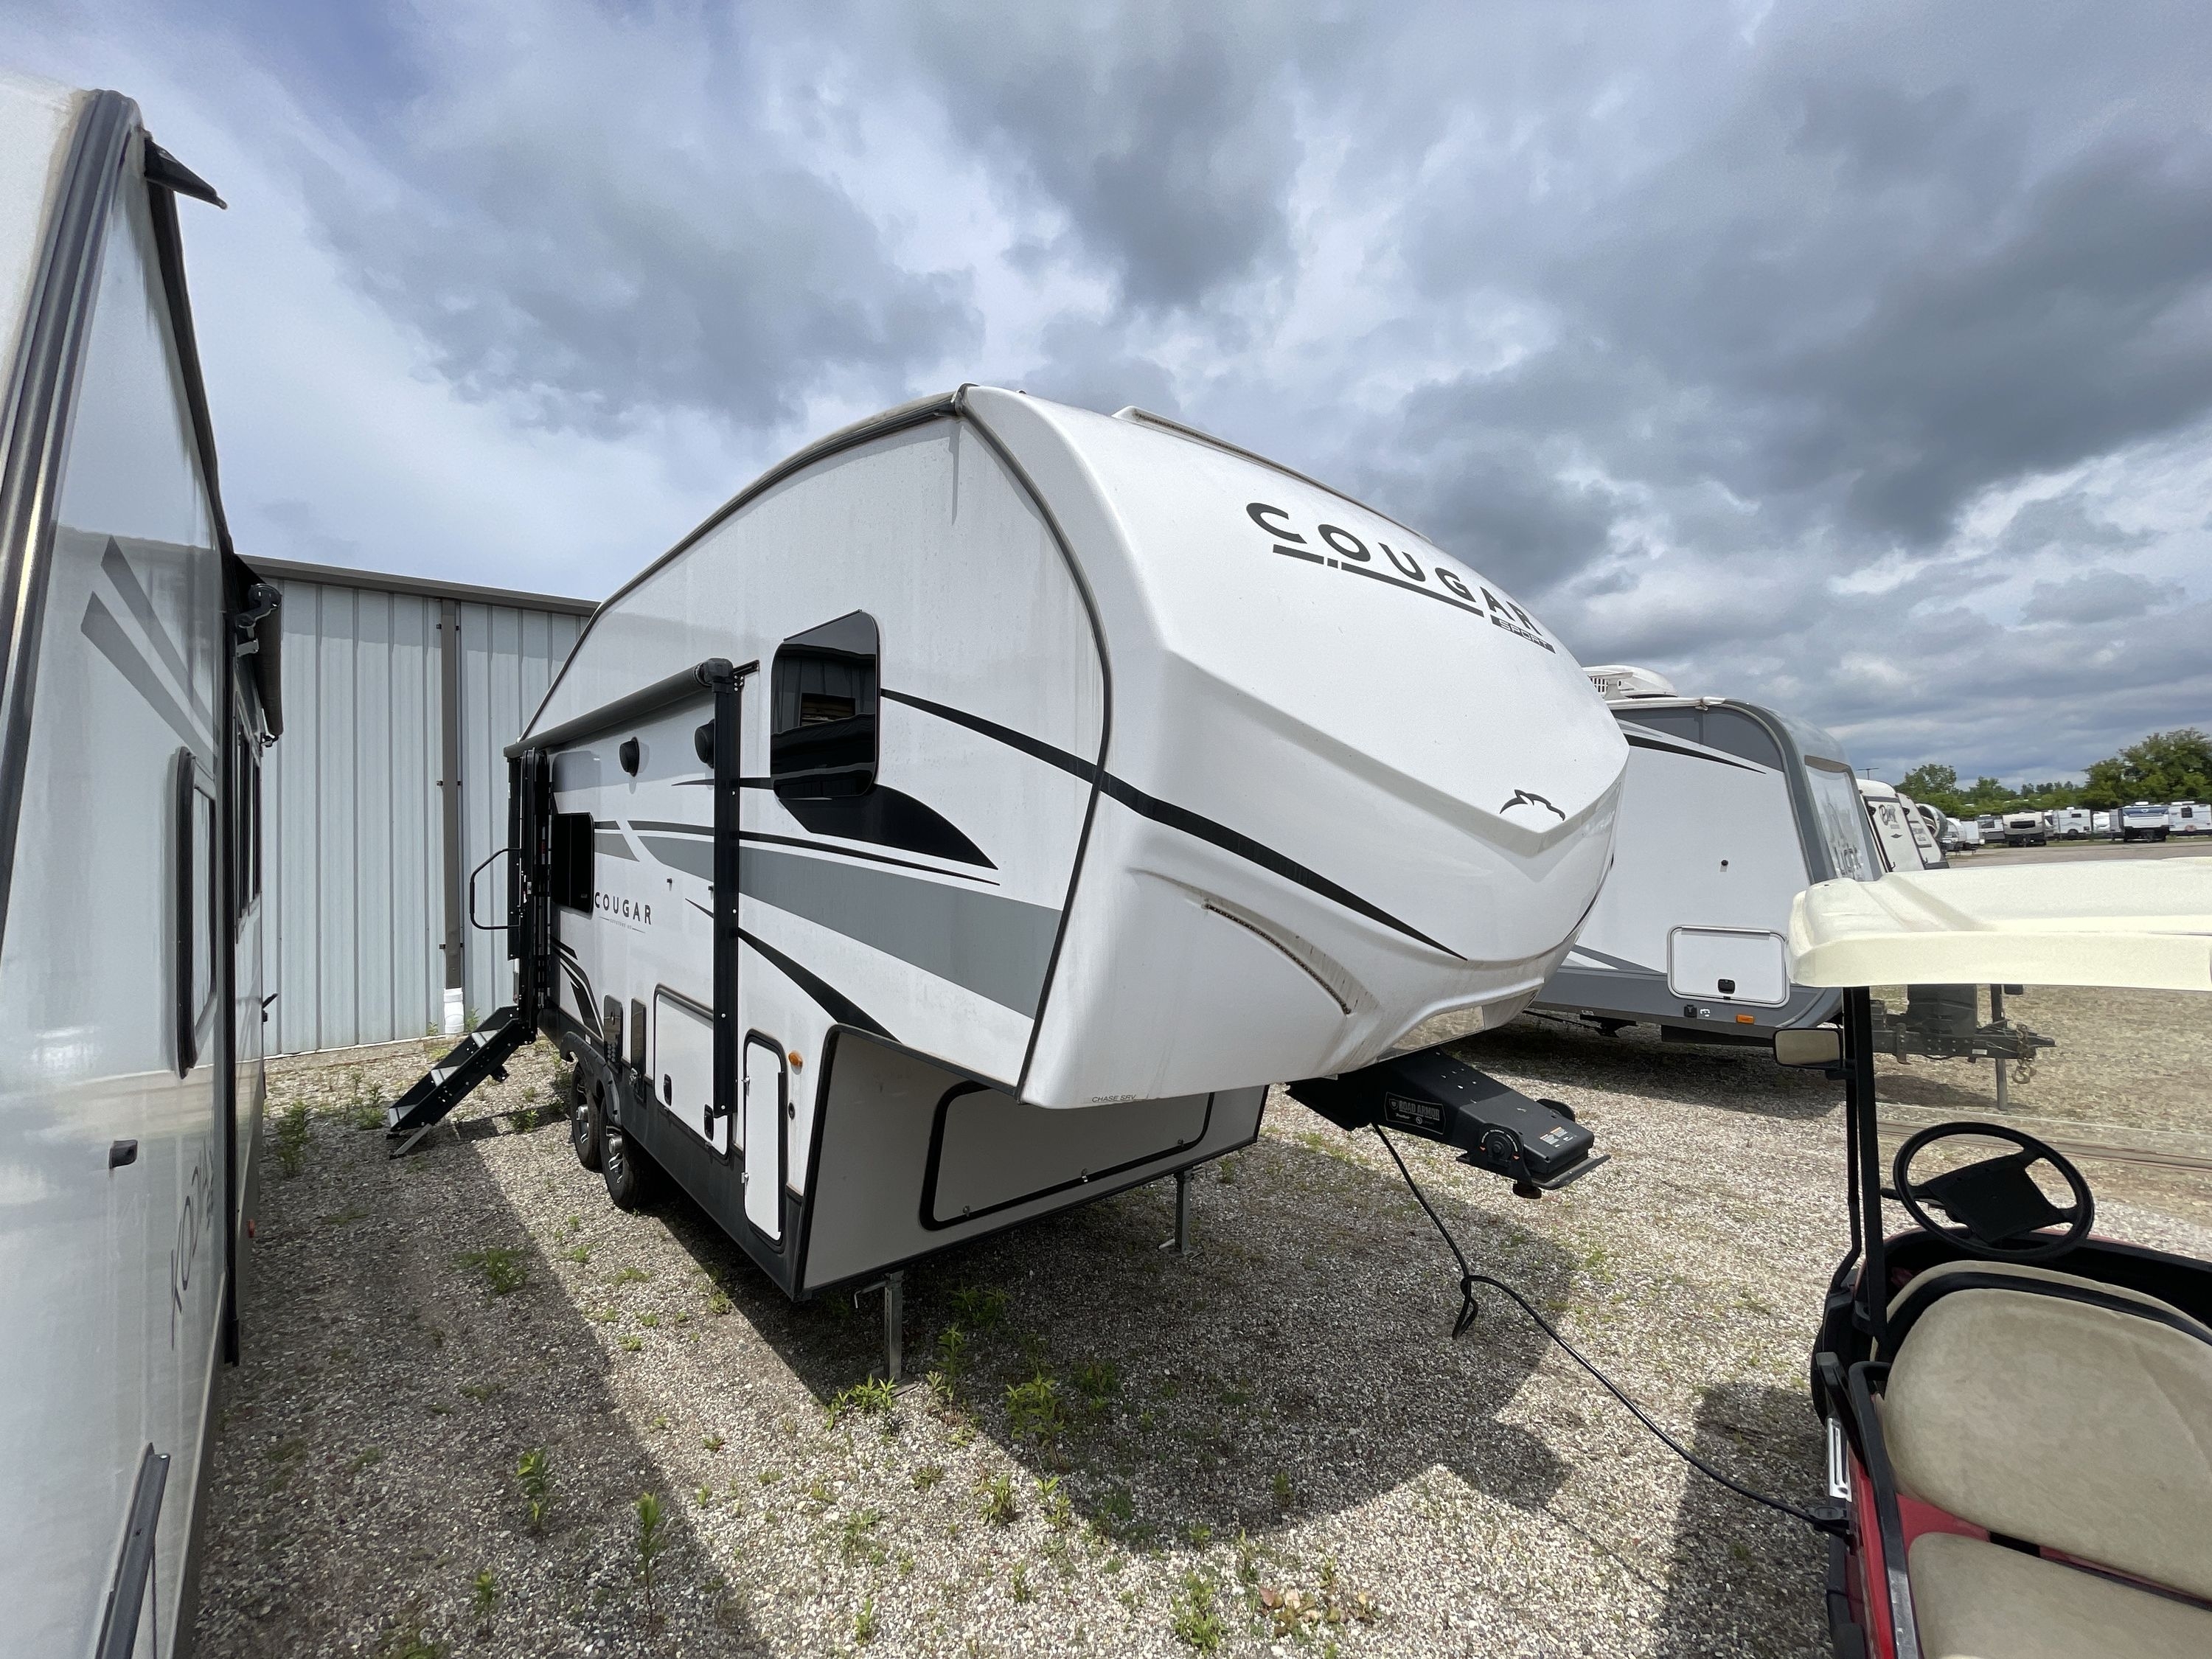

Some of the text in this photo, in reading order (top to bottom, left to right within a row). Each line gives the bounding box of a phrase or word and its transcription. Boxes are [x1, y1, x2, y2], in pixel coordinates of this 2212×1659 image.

[1245, 502, 1543, 637] COUGAR
[1498, 619, 1548, 649] SPORT
[594, 891, 652, 925] COUGAR
[1091, 1095, 1119, 1103] CHASE
[1399, 1100, 1416, 1113] ROAD
[1417, 1105, 1440, 1120] ARMOR
